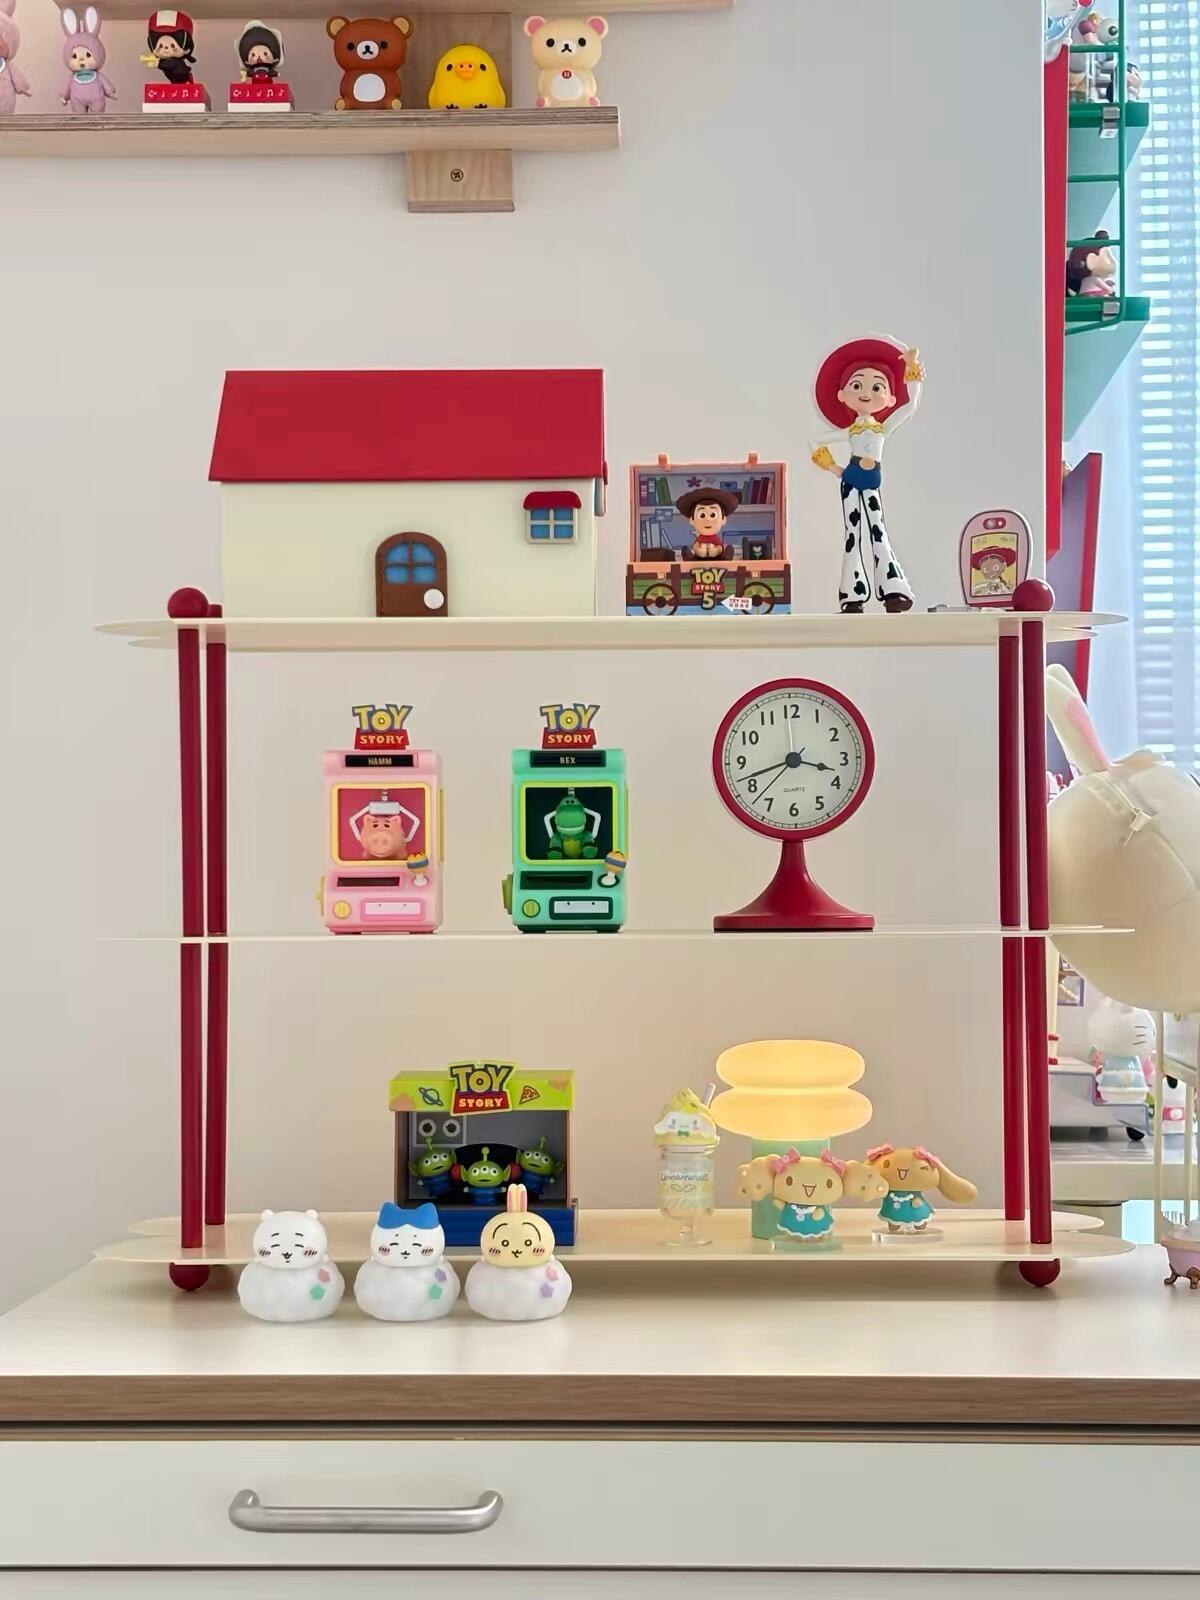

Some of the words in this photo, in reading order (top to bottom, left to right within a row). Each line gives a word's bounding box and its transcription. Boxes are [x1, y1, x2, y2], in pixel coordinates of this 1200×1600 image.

[691, 568, 727, 584] TOY
[702, 591, 716, 609] 5
[352, 704, 413, 731] TOY
[540, 703, 600, 731] TOY
[761, 711, 774, 726] 11
[784, 704, 800, 719] 12
[815, 709, 820, 723] 1
[360, 735, 404, 744] STORY
[547, 734, 591, 744] STORY
[742, 730, 759, 745] 10
[829, 727, 839, 742] 2
[368, 757, 392, 766] HAMM
[560, 756, 576, 765] REX
[736, 755, 747, 769] 9
[840, 752, 849, 766] 3
[748, 779, 757, 793] 8
[830, 775, 841, 790] 4
[764, 798, 774, 812] 7
[789, 802, 799, 817] 6
[815, 796, 824, 810] 5
[450, 1064, 513, 1092] TOY
[458, 1097, 504, 1108] STORY
